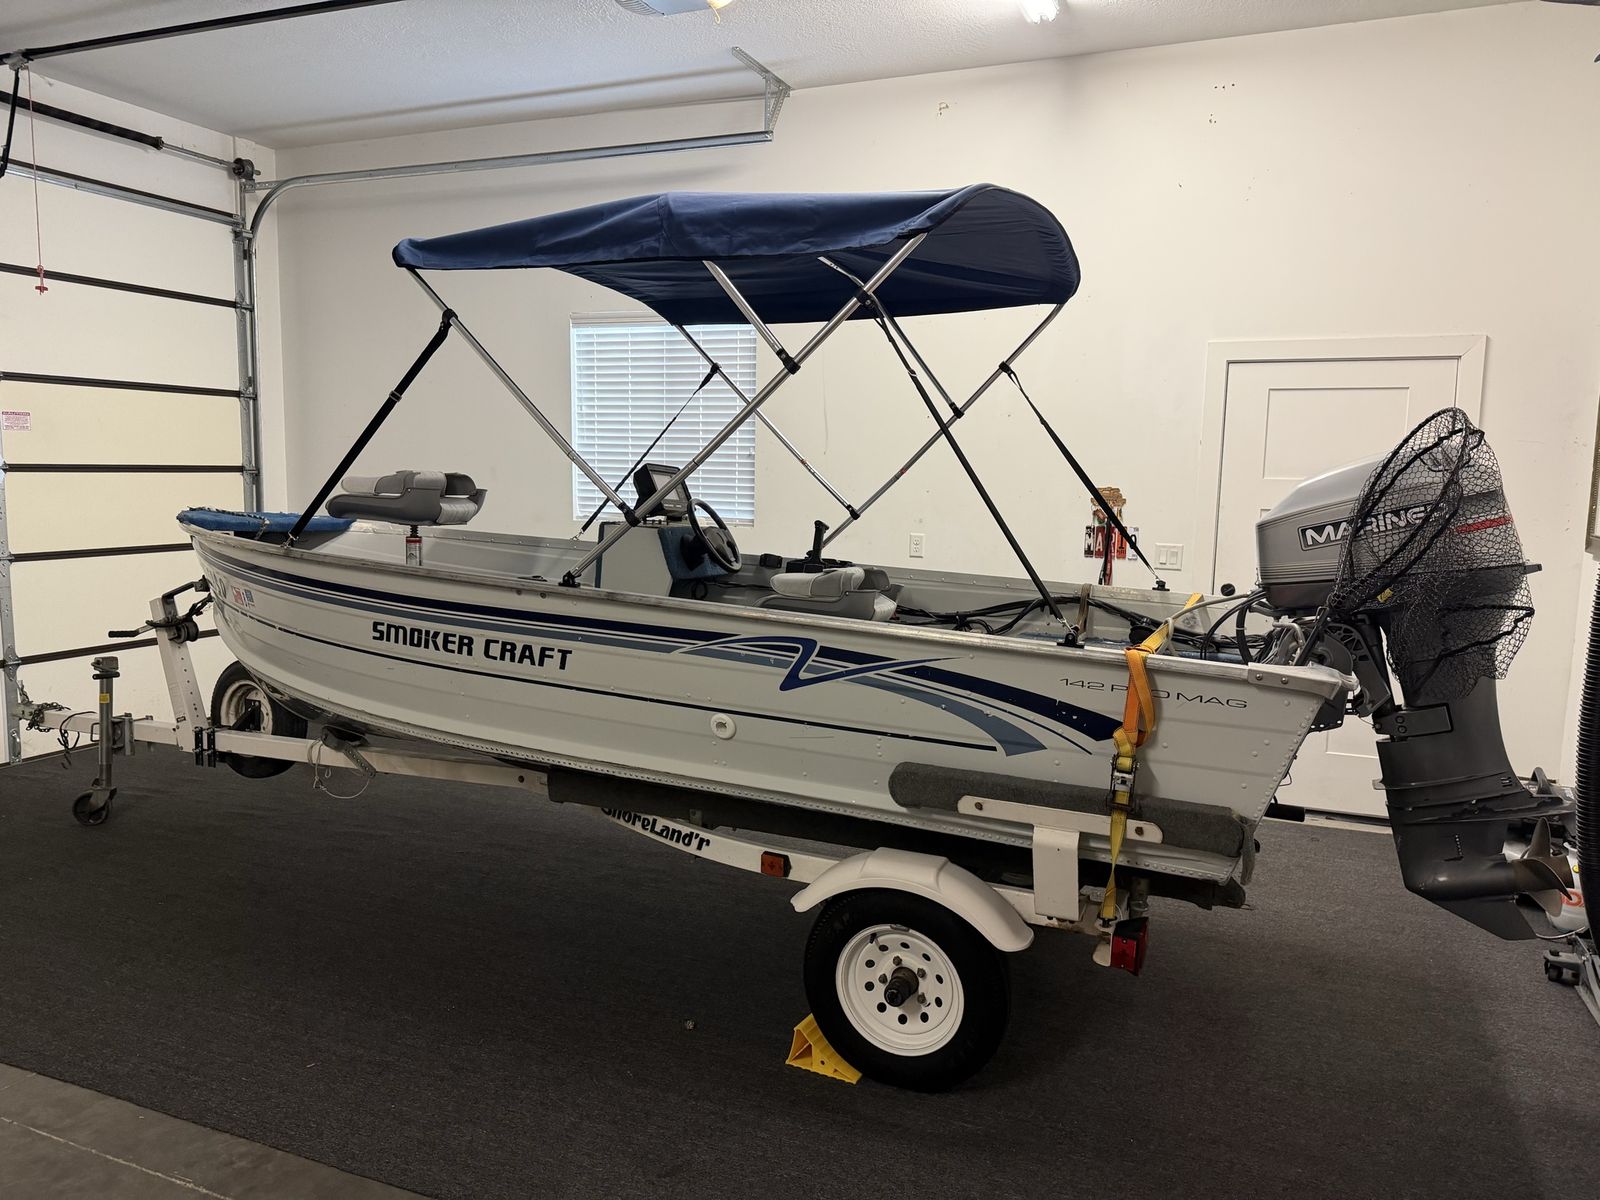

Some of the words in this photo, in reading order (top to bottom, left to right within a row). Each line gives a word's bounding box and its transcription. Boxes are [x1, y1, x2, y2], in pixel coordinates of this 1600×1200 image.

[1305, 504, 1443, 547] MARINE
[372, 621, 475, 657] SMOKER
[484, 638, 573, 671] CRAFT
[1060, 678, 1105, 692] 142
[1111, 684, 1170, 699] PO
[1176, 692, 1248, 709] MAG
